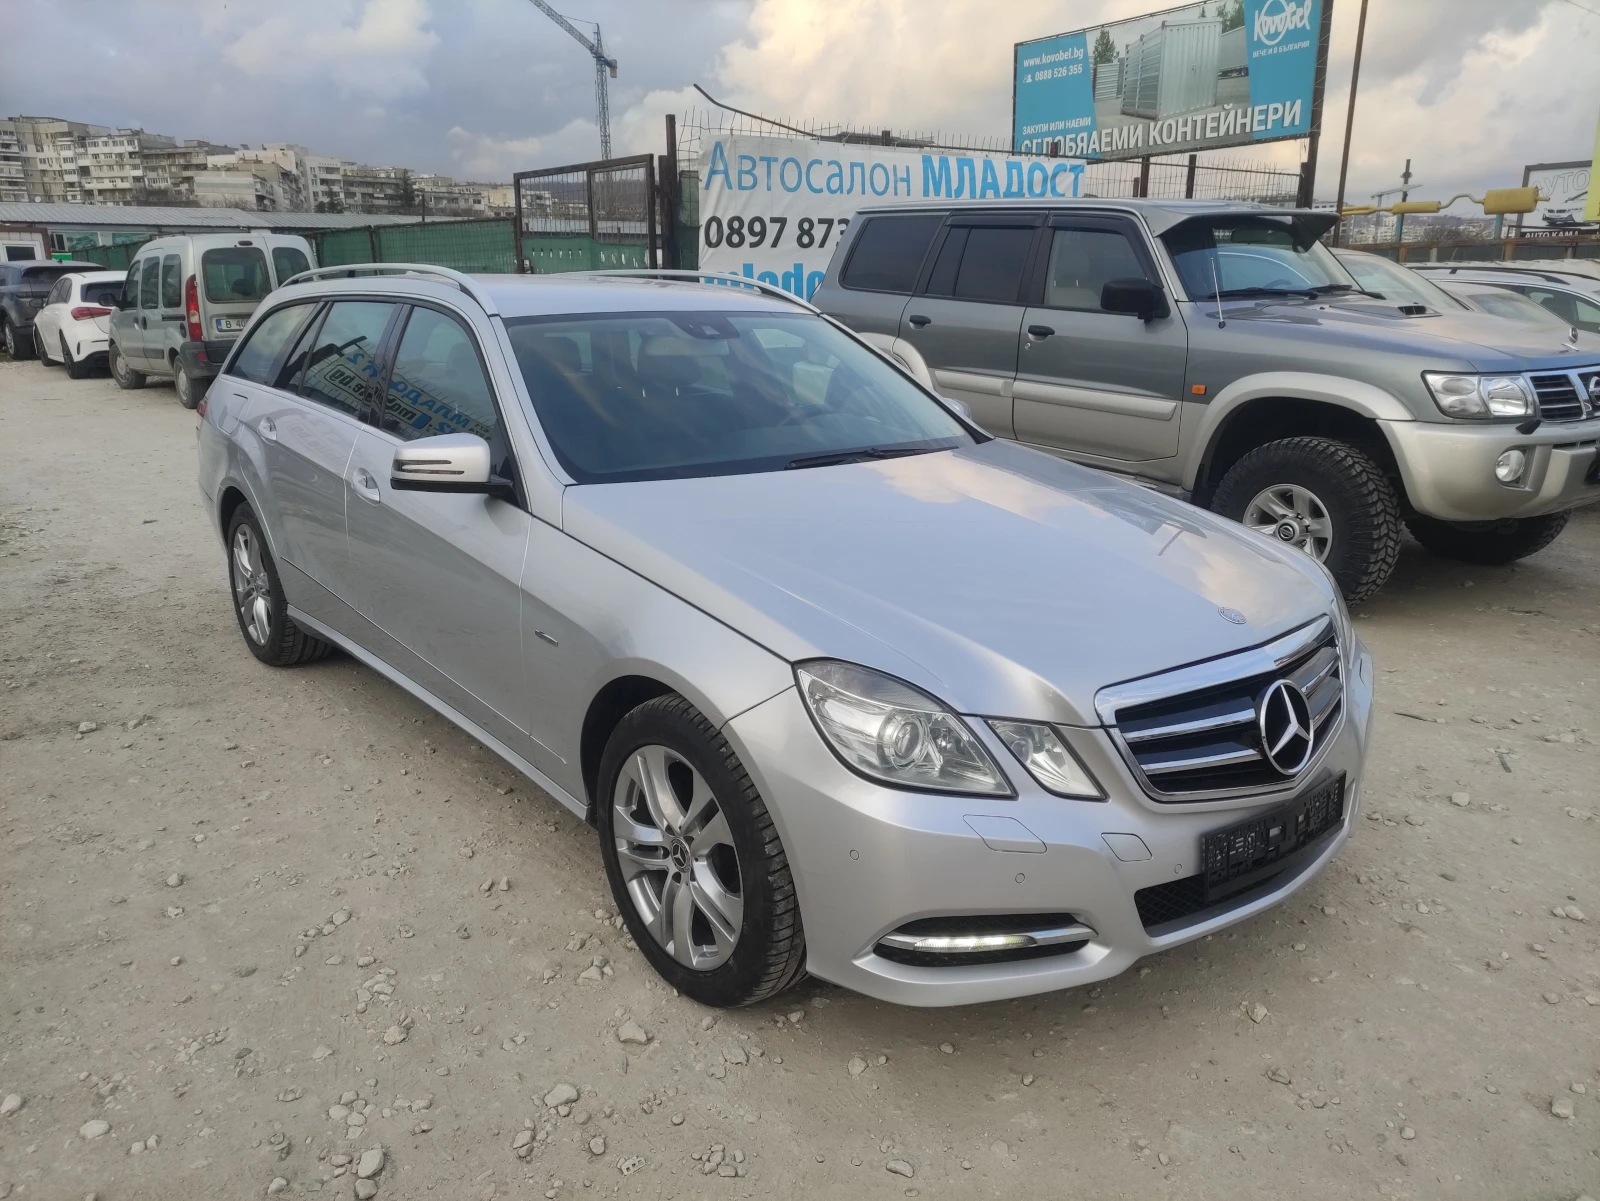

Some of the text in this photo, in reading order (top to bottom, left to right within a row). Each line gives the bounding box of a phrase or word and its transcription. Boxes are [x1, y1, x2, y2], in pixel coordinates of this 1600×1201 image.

[1023, 46, 1084, 67] www.kovobel.bg
[1252, 40, 1310, 58] ВЕЧЕ И В БЪЛГАРИЯ
[1034, 63, 1083, 81] 0888 526 355
[1022, 116, 1092, 135] ЗАКУПИ ИЛИ НАЕМИ
[1149, 99, 1302, 146] КОНТЕЙНЕРИ
[704, 140, 1085, 199] Автосалон МЛАДОСТ
[704, 215, 788, 249] 0897
